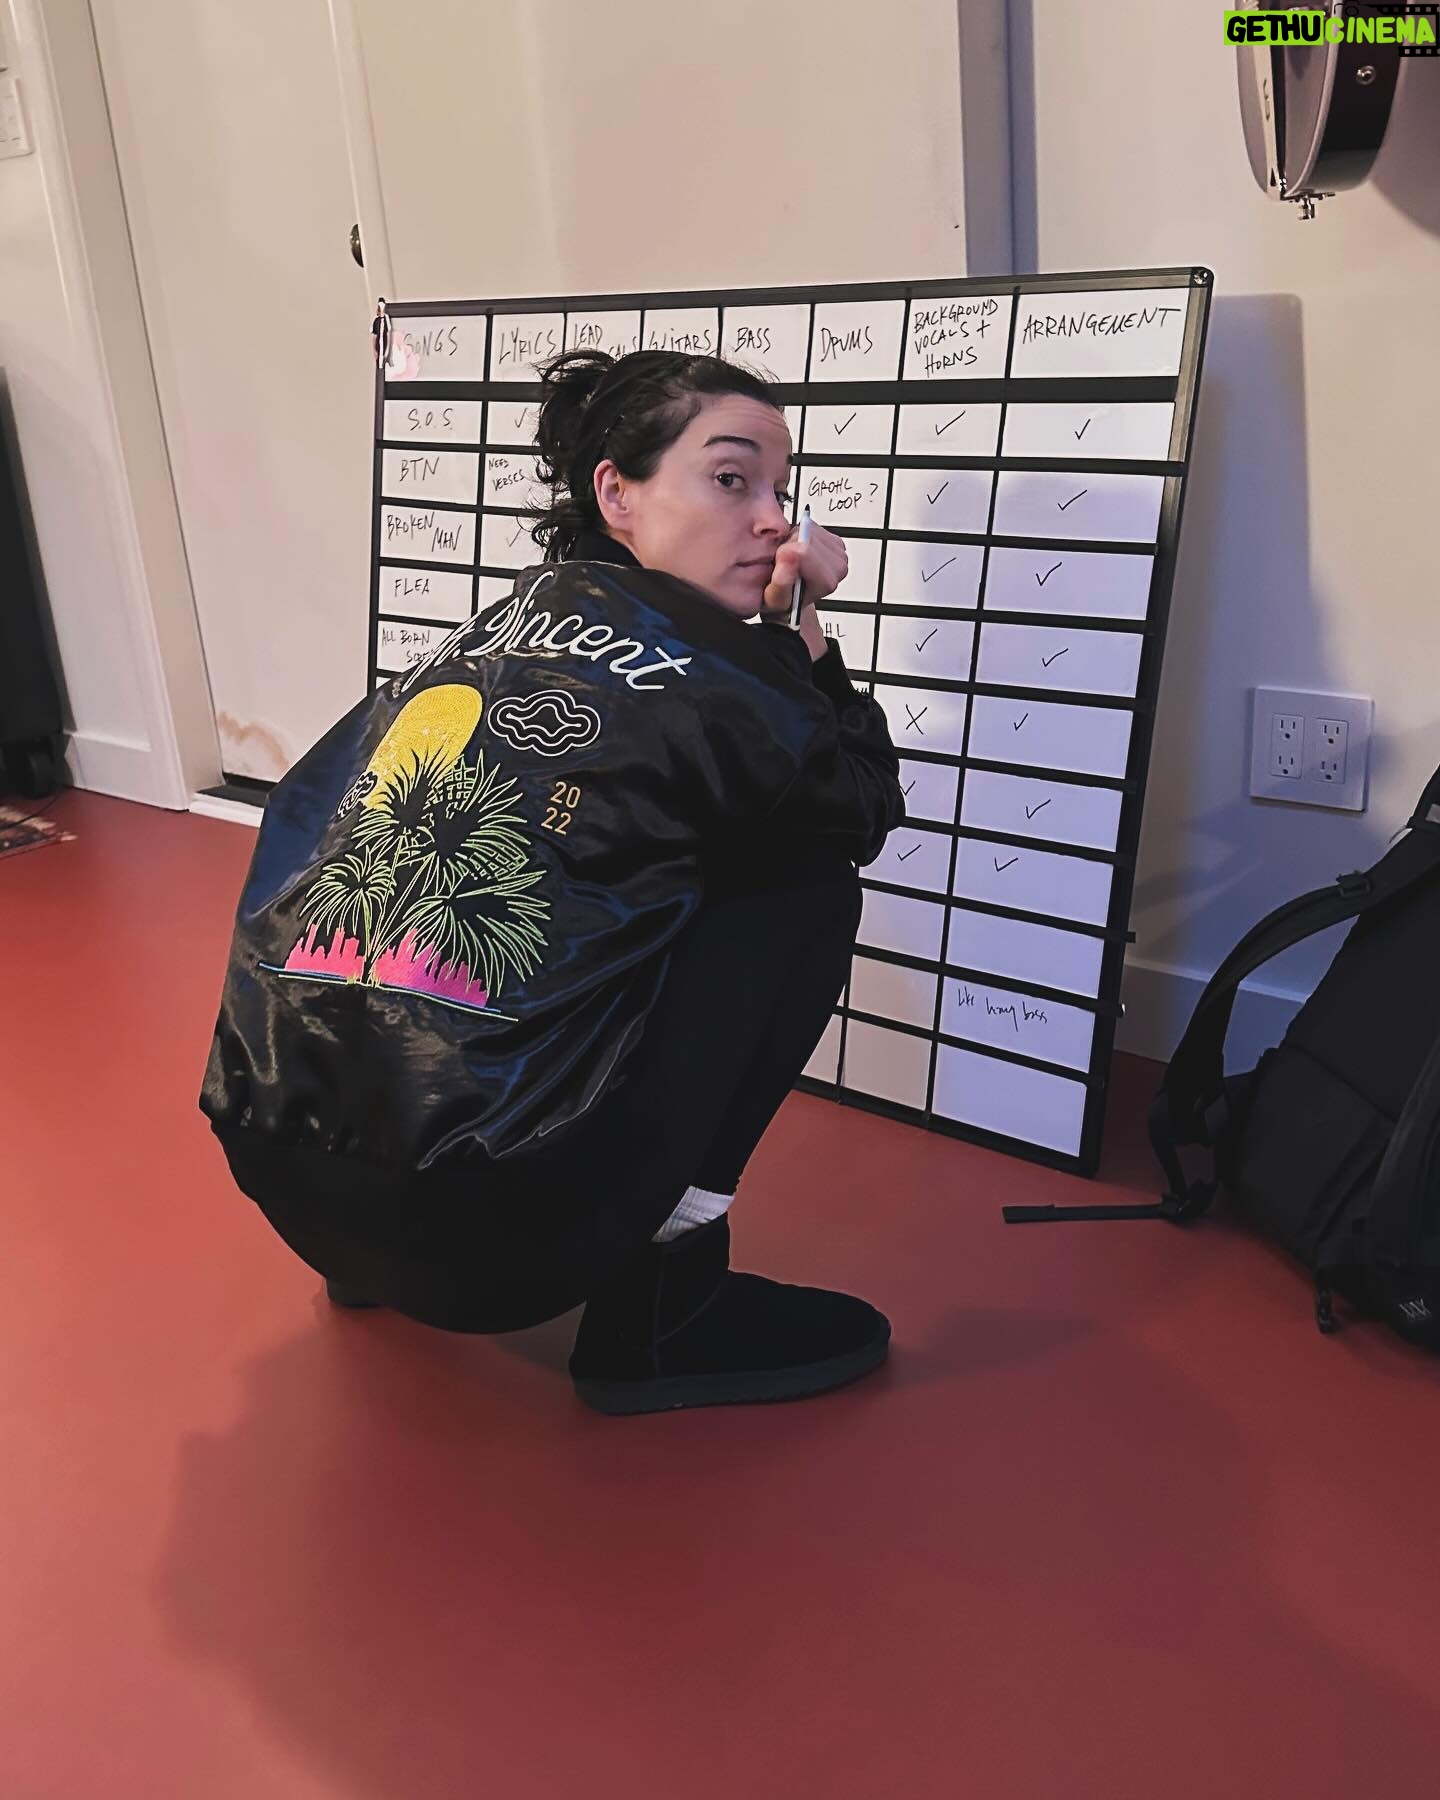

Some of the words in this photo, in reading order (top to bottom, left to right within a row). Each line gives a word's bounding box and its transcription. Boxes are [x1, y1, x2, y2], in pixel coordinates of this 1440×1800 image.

[913, 298, 999, 334] BACKGROUND
[1022, 307, 1181, 345] ARRANGEMENT
[403, 326, 458, 356] SONGS
[499, 327, 557, 364] LYRICS
[573, 323, 604, 351] LEAD
[735, 326, 772, 354] BASS
[820, 327, 874, 362] DRUMS
[914, 326, 970, 354] VOCALS
[924, 346, 978, 377] HORNS
[399, 456, 440, 482] BTN
[488, 458, 509, 470] NEED
[492, 469, 526, 491] VERSES
[828, 492, 862, 512] LOOP
[387, 512, 435, 541] BROKEN
[431, 524, 462, 552] MAN
[394, 578, 430, 597] FLEA
[381, 627, 397, 646] ALL
[400, 630, 430, 646] BORN
[464, 571, 692, 690] Vincent
[551, 781, 581, 808] 20
[541, 807, 572, 836] 22
